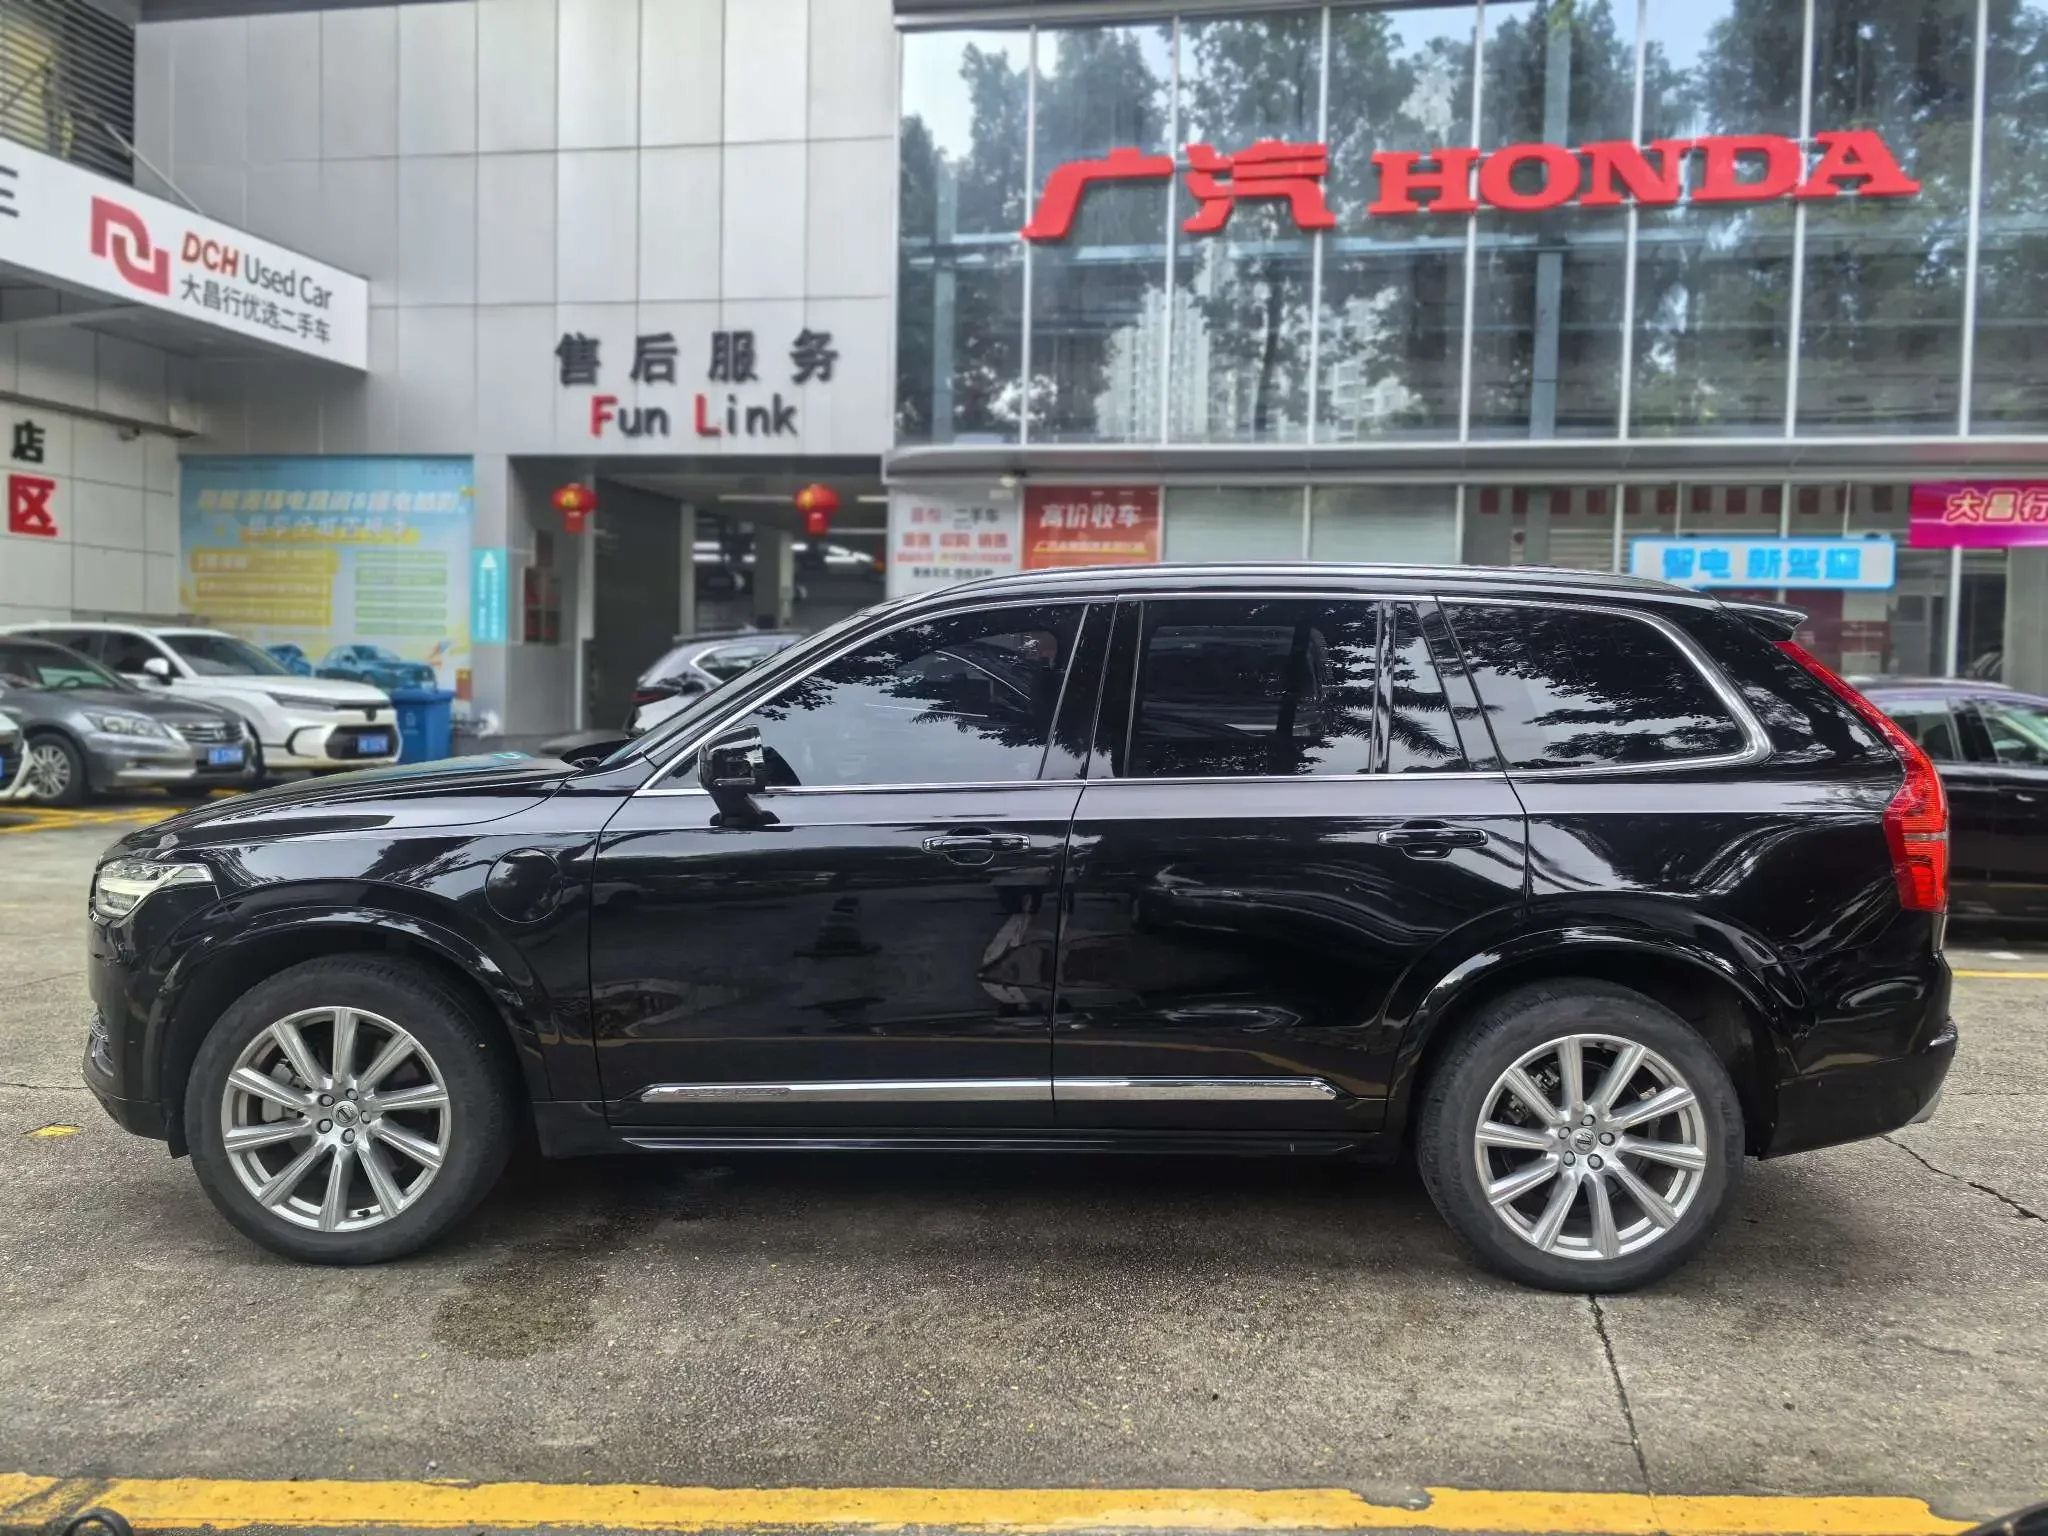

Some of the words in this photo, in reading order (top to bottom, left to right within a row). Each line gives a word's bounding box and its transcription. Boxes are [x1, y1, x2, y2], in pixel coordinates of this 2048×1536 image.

[1020, 139, 1336, 241] 广汽
[1368, 130, 1921, 216] HONDA
[180, 230, 240, 279] DCH
[243, 252, 297, 299] Used
[299, 274, 334, 310] Car
[179, 272, 331, 345] 大昌行优选二手车
[554, 327, 840, 388] 售后服务
[11, 420, 46, 464] 店
[590, 394, 670, 439] Fun
[694, 392, 800, 439] Link
[8, 474, 59, 538] 区
[1040, 502, 1143, 530] 高价收车
[1945, 489, 2048, 524] 大昌行
